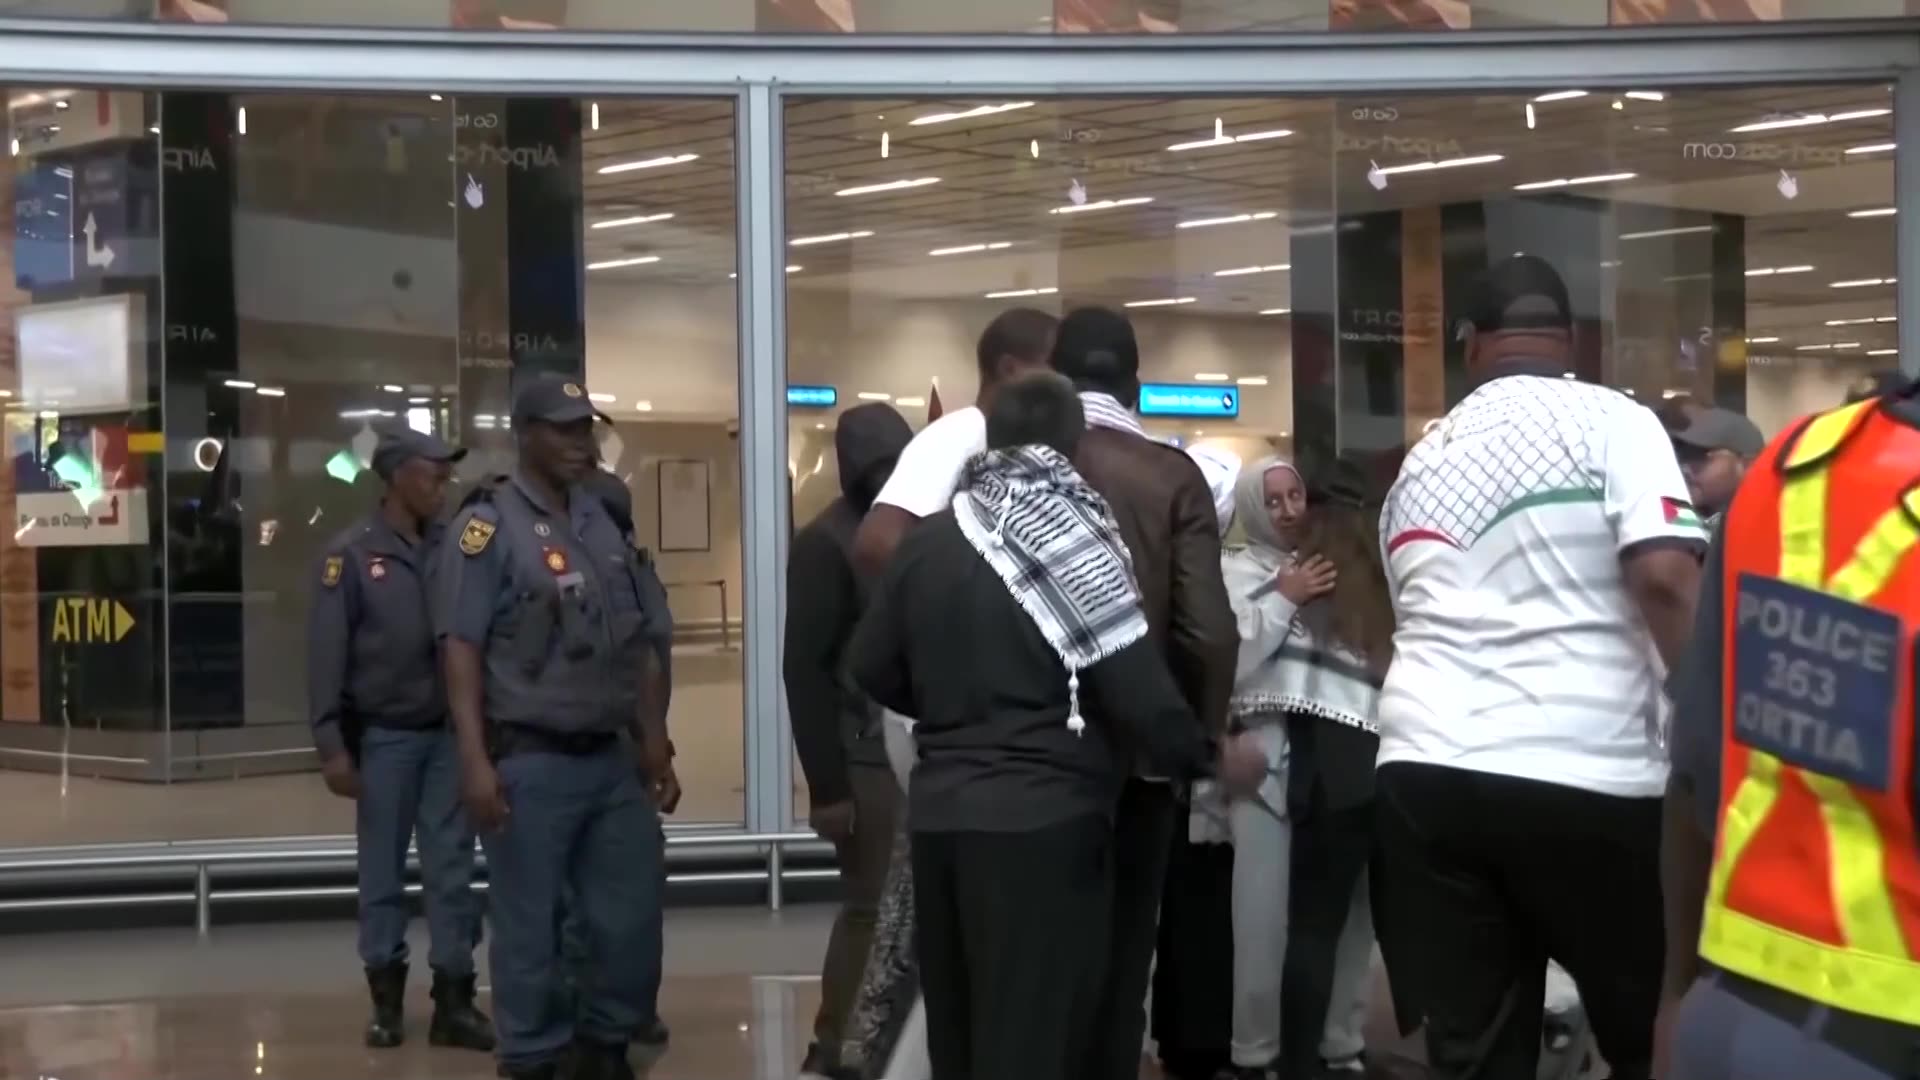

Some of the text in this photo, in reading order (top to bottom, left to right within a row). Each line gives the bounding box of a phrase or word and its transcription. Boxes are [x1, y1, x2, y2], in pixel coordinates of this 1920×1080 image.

[53, 597, 111, 644] ATM
[1738, 590, 1893, 673] POLICE
[1763, 651, 1837, 708] 363
[1737, 692, 1864, 772] ORTIA
